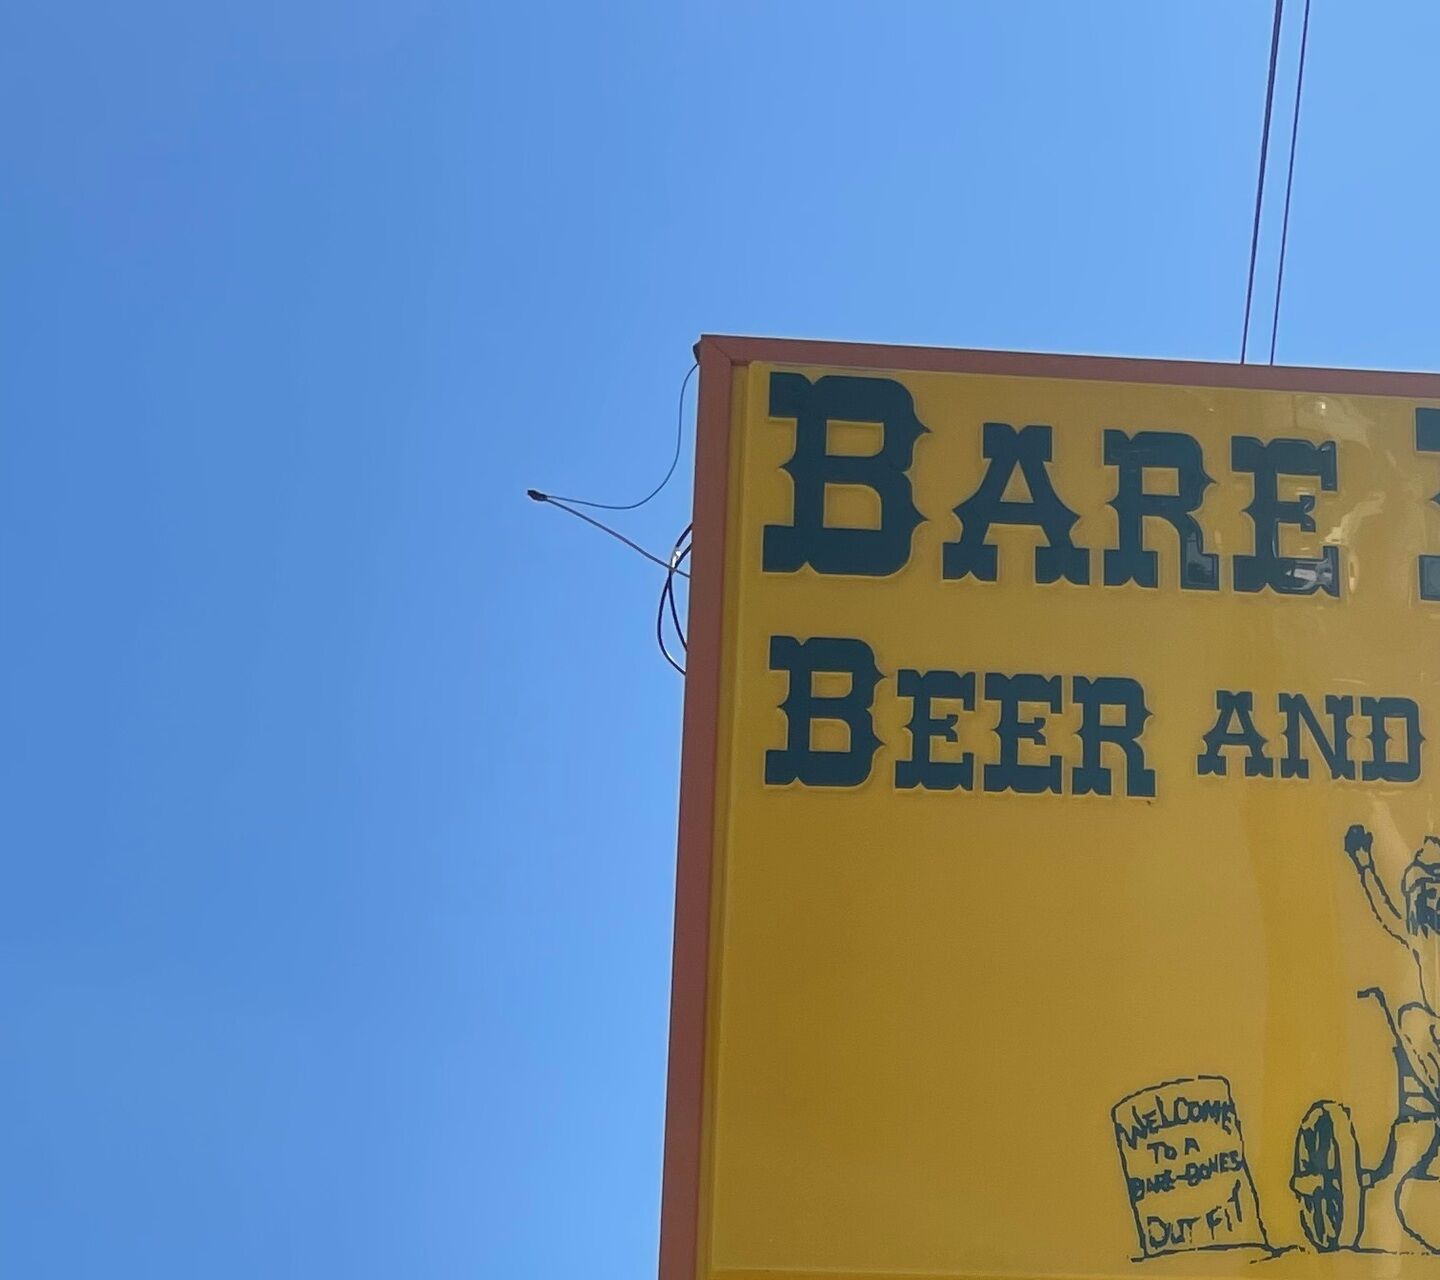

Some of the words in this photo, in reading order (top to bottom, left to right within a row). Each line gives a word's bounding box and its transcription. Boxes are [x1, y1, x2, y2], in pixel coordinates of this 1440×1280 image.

[762, 371, 1341, 598] BARE
[764, 634, 1156, 798] BEER
[1197, 689, 1426, 783] AND
[1116, 1095, 1236, 1149] WELCOME
[1147, 1141, 1178, 1164] TO
[1184, 1137, 1200, 1155] A
